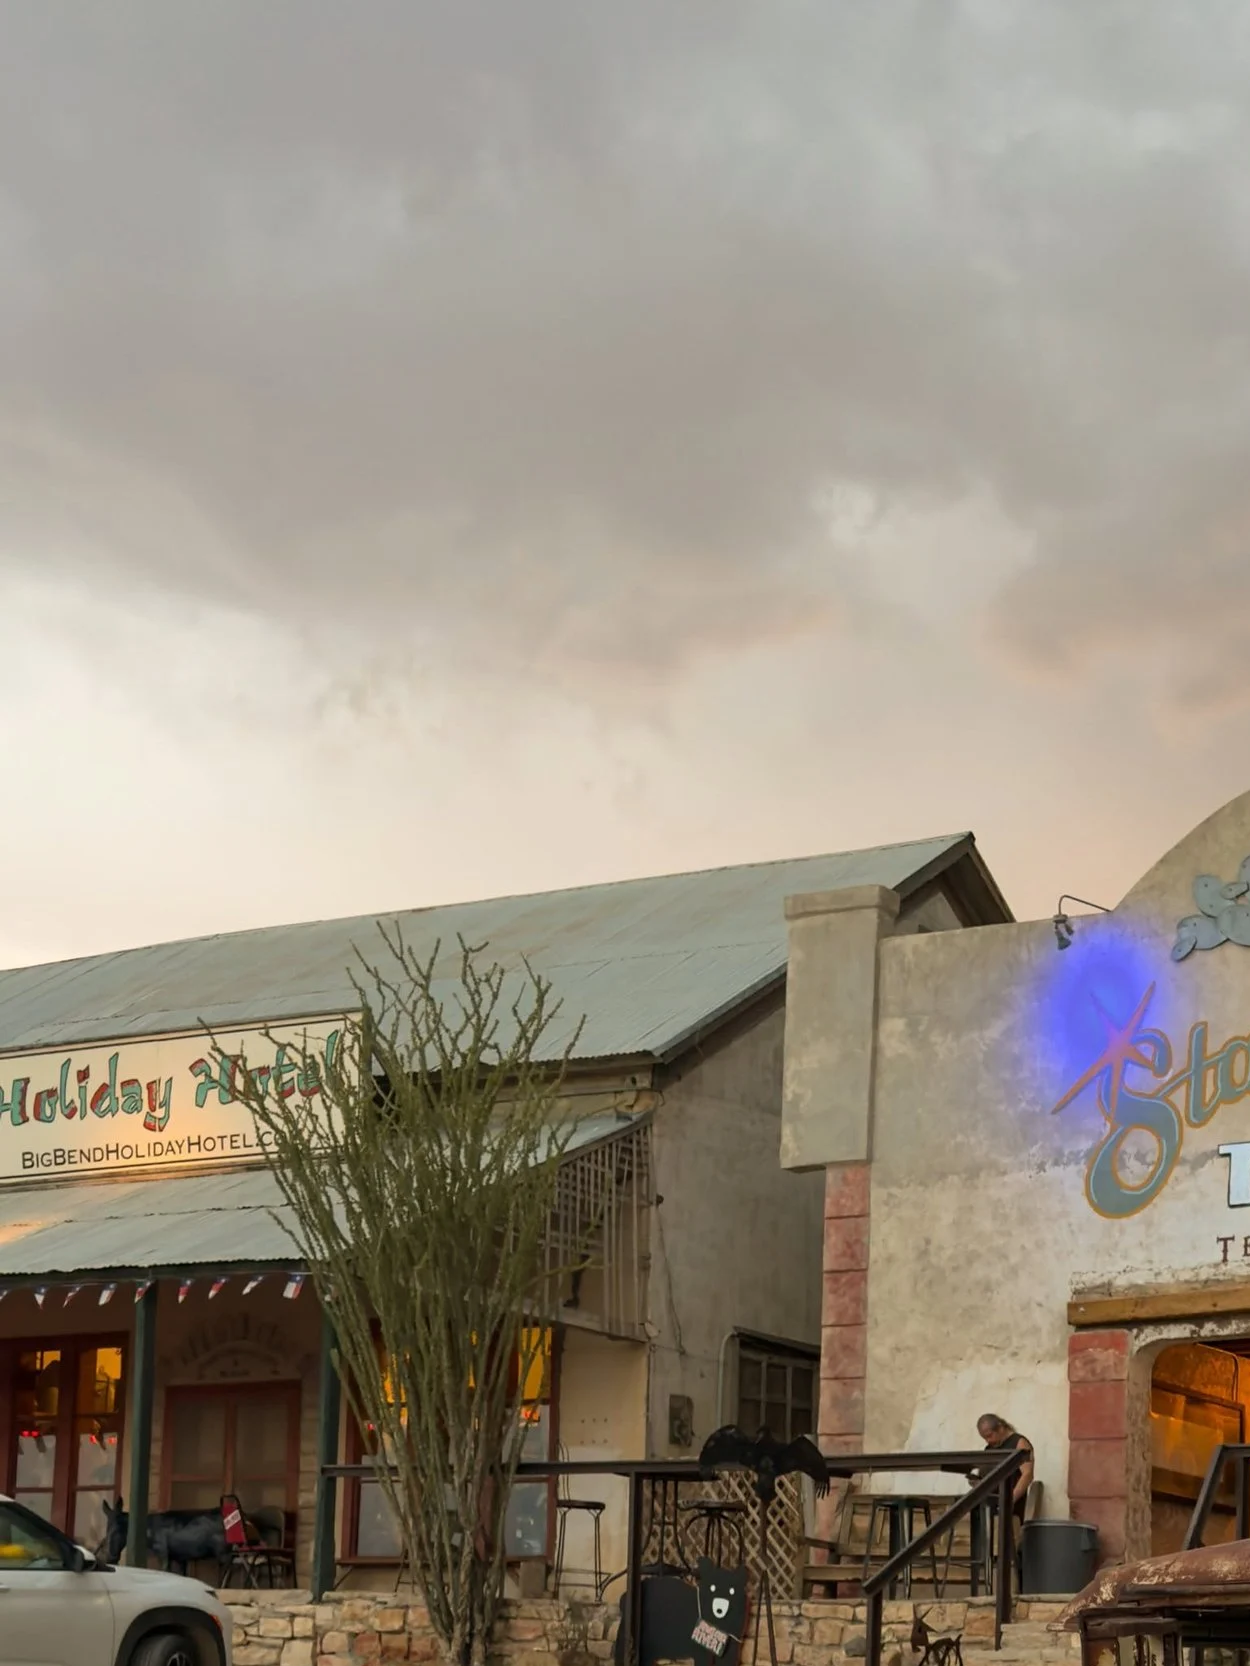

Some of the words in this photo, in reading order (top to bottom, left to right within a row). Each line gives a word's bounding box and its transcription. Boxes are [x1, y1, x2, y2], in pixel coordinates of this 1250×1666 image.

[0, 1052, 174, 1132] Holiday
[189, 1029, 339, 1108] Hotel
[21, 1130, 292, 1170] BIGBENDHOLIDAYHOTEL.CO
